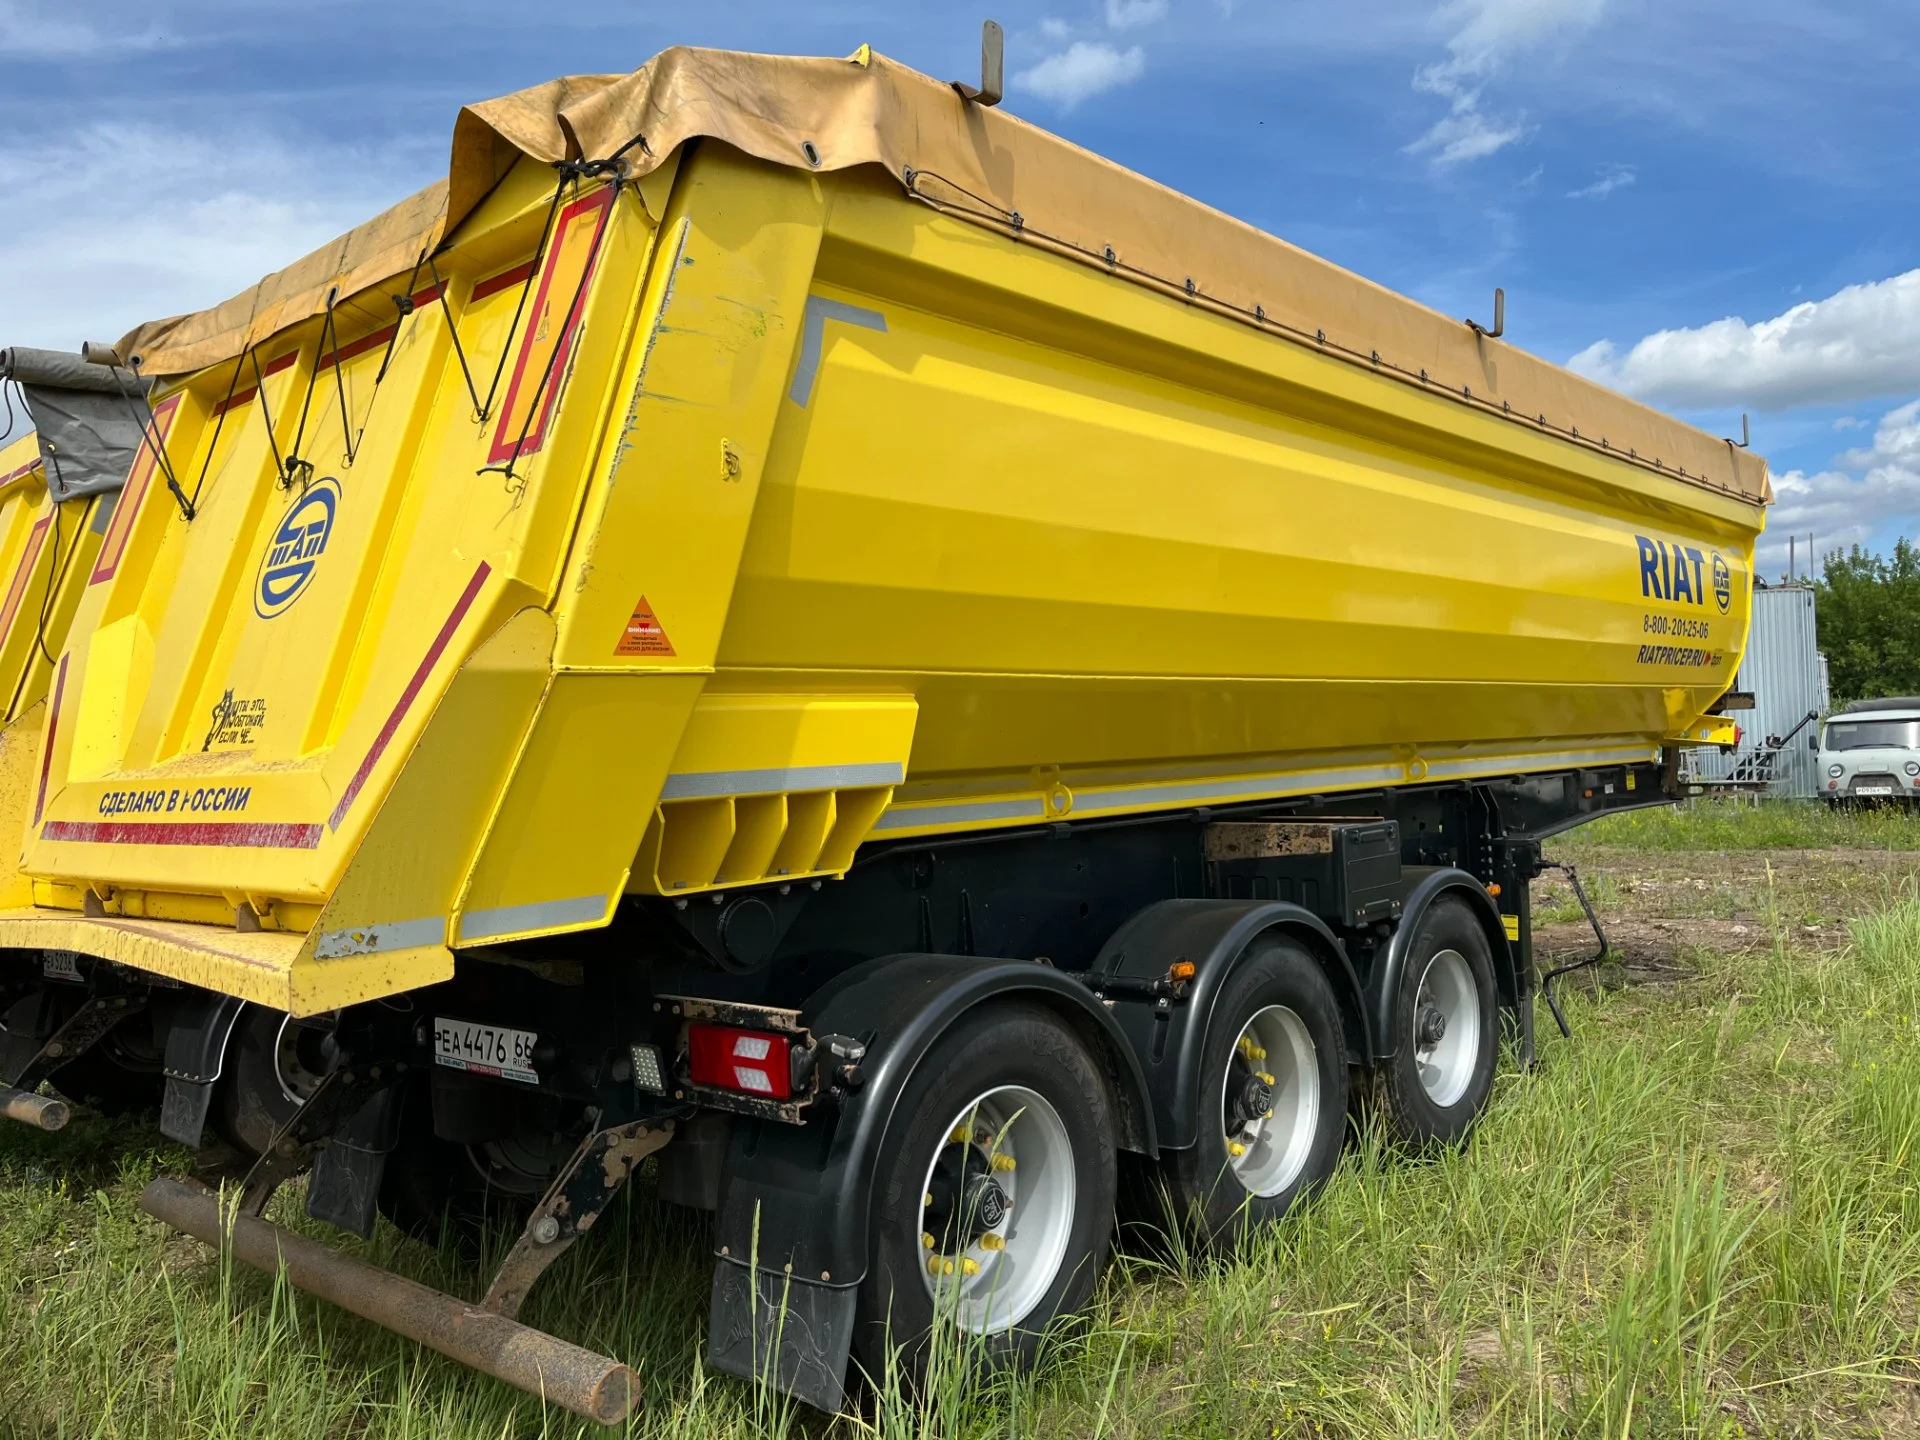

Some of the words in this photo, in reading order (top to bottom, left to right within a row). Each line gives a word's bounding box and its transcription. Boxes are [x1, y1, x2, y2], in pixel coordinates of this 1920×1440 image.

[1635, 535, 1705, 605] RIAT
[1643, 614, 1709, 639] 8-800-201-25-06
[1637, 644, 1706, 667] RIATPRICEP.RU
[99, 789, 166, 817] СДЕЛАНО
[166, 789, 180, 812] В
[514, 1034, 533, 1059] 66
[512, 1057, 527, 1068] RUS
